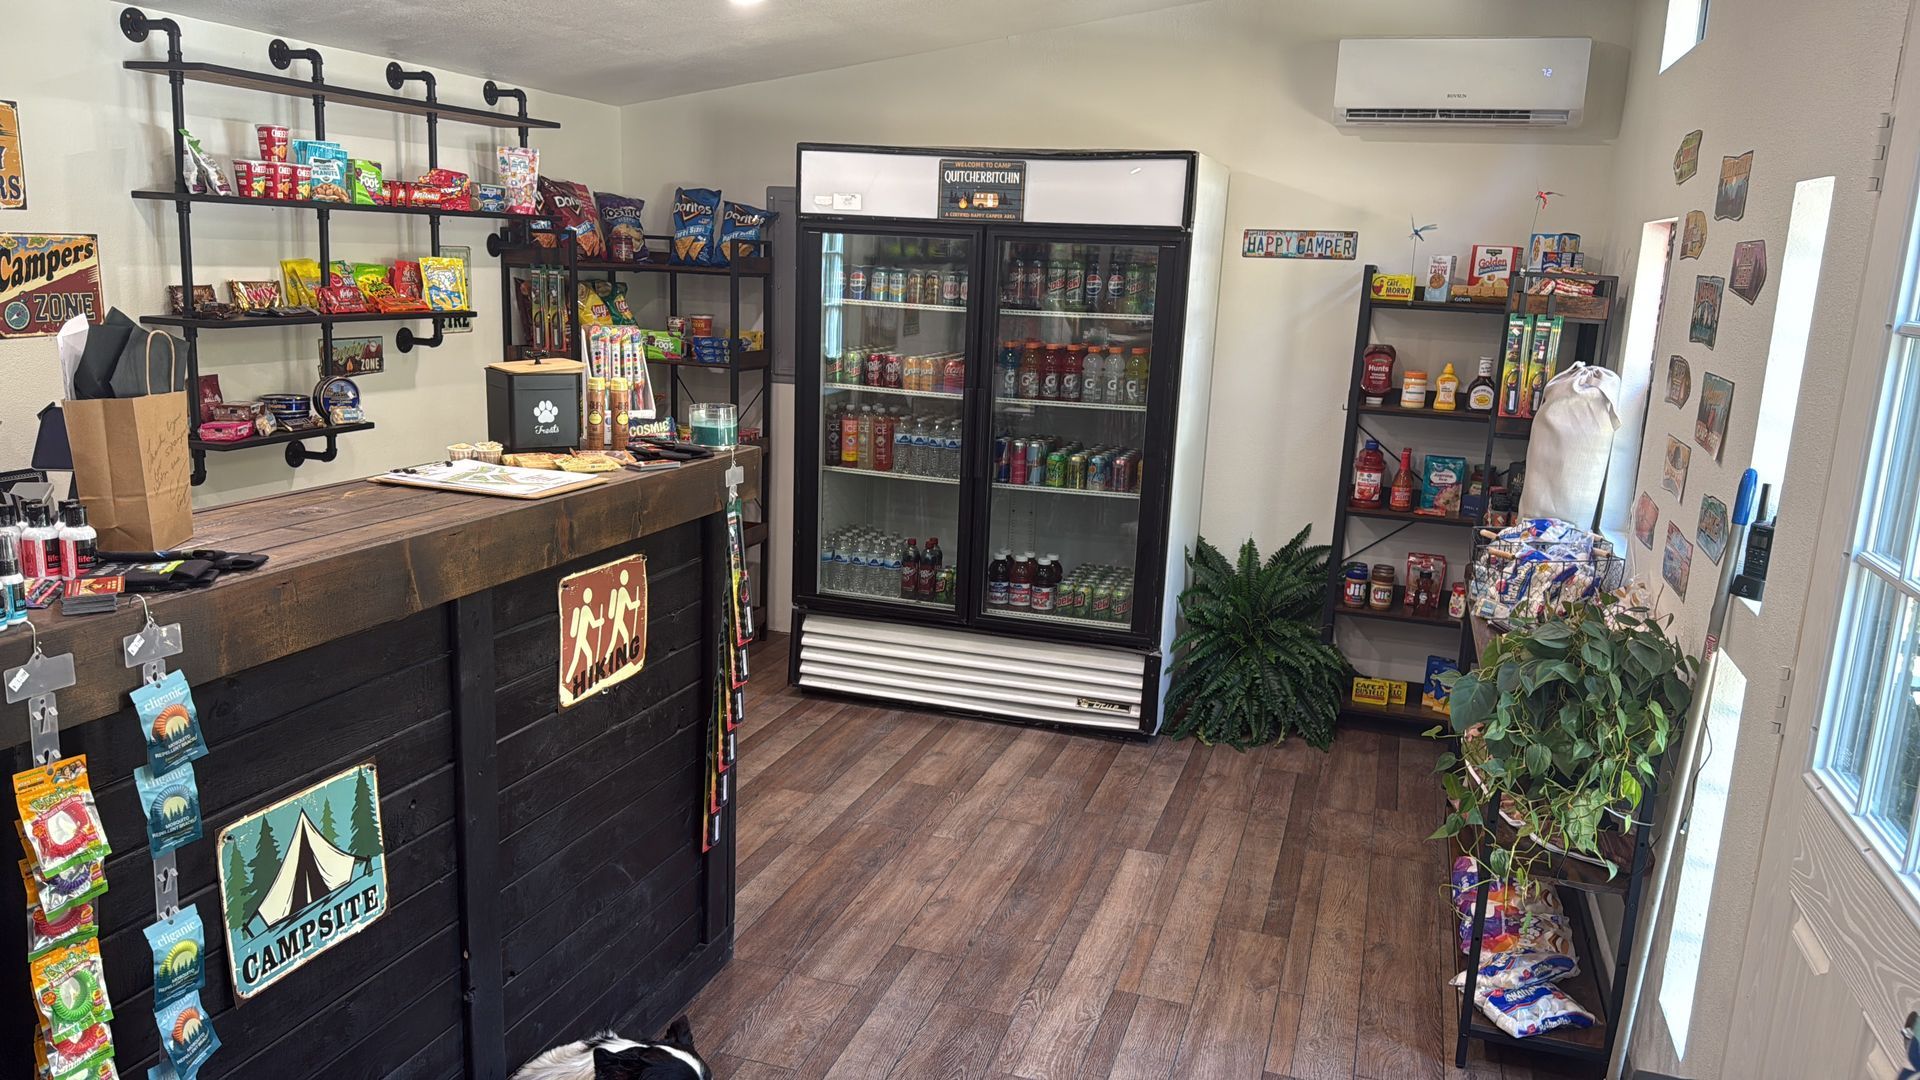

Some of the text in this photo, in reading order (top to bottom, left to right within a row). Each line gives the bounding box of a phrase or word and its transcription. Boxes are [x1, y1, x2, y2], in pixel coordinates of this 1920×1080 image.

[944, 170, 1020, 184] QUITCHERBITCHIN
[673, 202, 712, 215] Doritos
[724, 210, 765, 226] Doritos
[1247, 236, 1352, 256] HAPPY CAMPER
[0, 242, 94, 292] Campers
[1479, 257, 1507, 268] Golden
[1386, 286, 1411, 295] MORRO
[33, 293, 96, 323] ZONE
[361, 358, 380, 371] ZONE
[534, 423, 560, 435] Treats
[628, 420, 670, 438] COSMIC
[1346, 583, 1367, 596] Jif
[1375, 590, 1391, 600] Jif
[573, 635, 640, 700] HIKING
[144, 687, 184, 712] cliganic
[168, 734, 191, 749] MOSQUITO
[165, 815, 190, 829] MOSQUITO
[157, 921, 198, 948] cliganic
[242, 884, 380, 986] CAMPSITE
